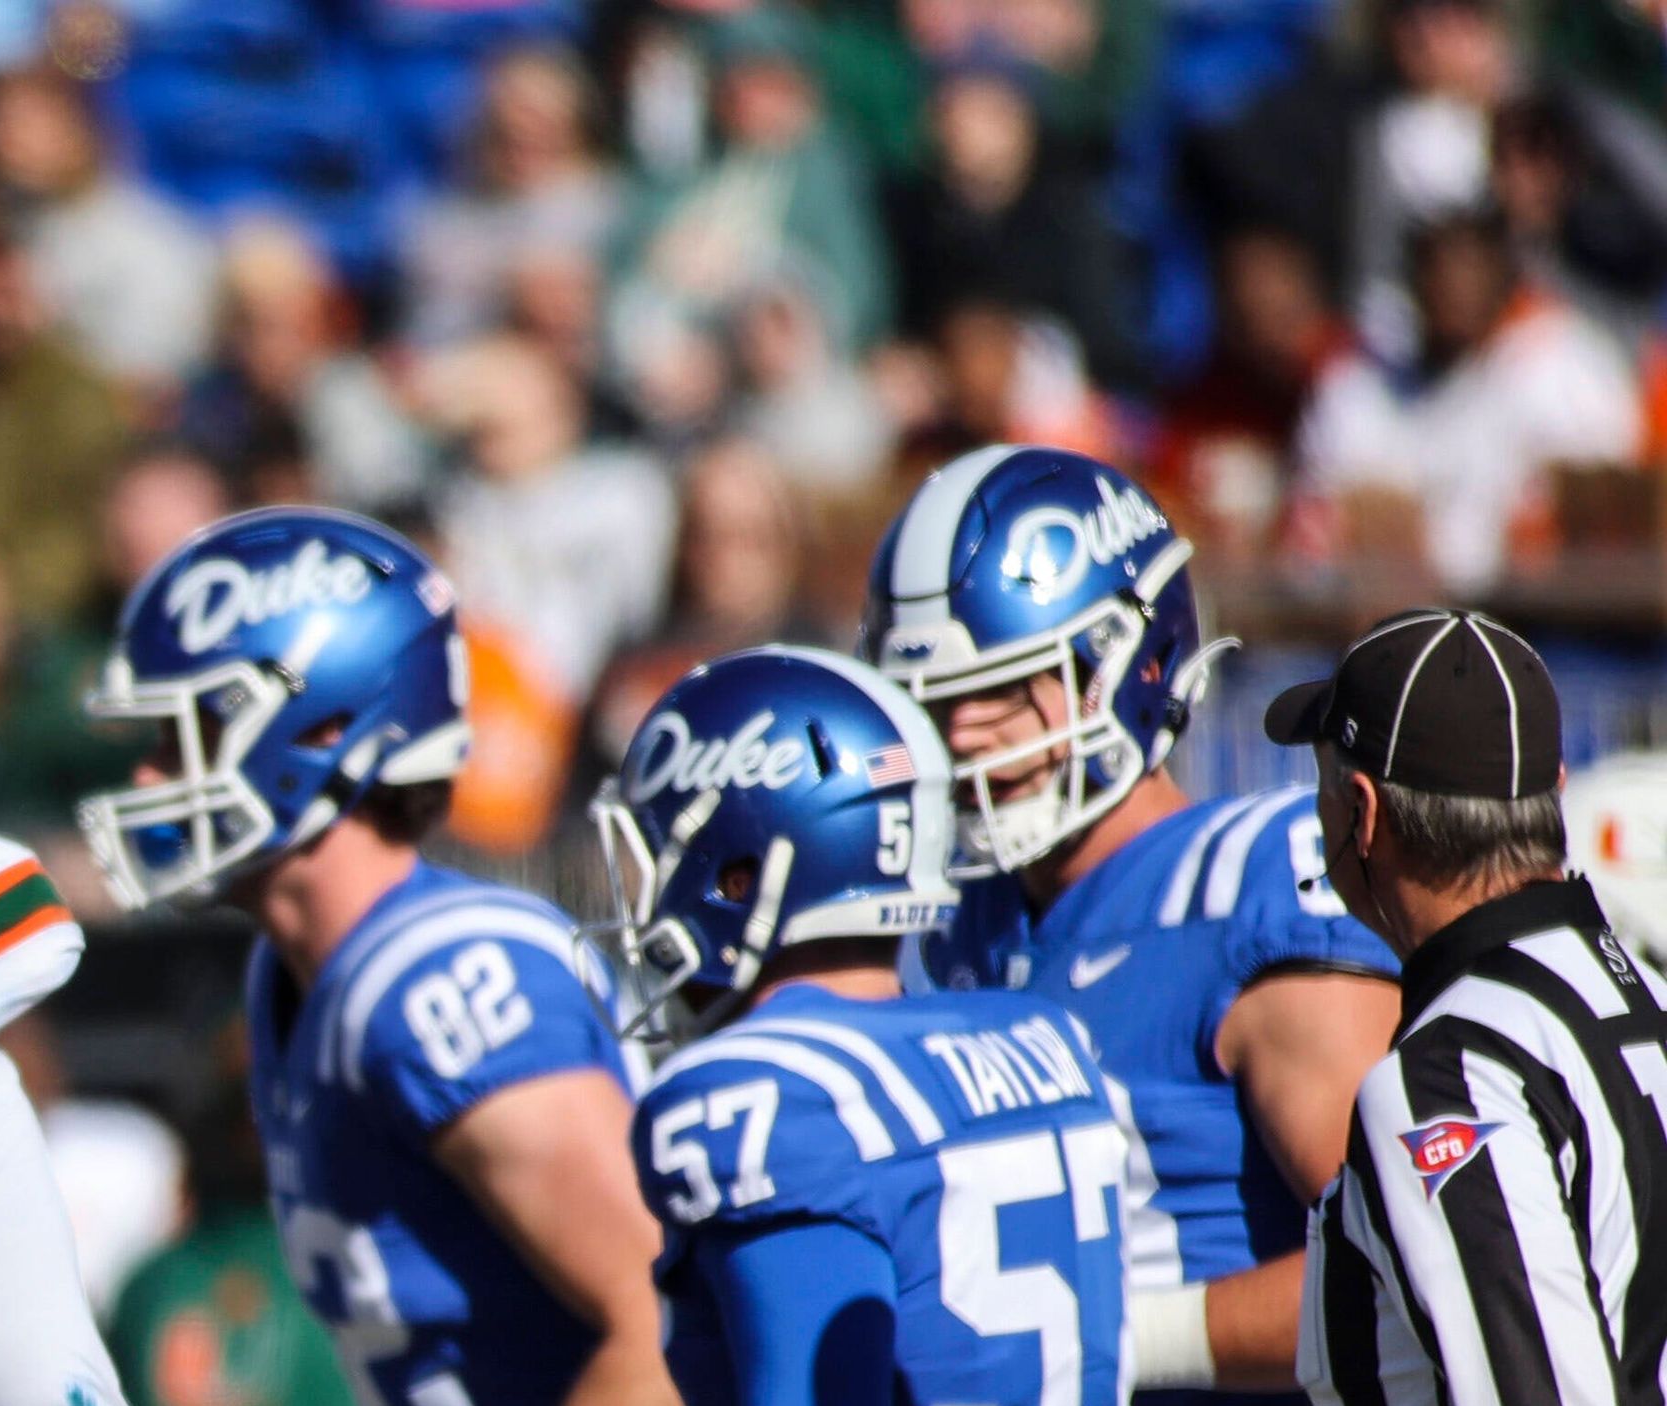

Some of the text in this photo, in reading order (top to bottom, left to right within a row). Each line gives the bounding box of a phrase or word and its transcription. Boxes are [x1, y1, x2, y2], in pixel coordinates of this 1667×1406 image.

[167, 539, 371, 655] Duke
[629, 709, 806, 803] Duke
[877, 803, 913, 875] 5
[404, 941, 533, 1078] 82
[651, 1079, 779, 1223] 57
